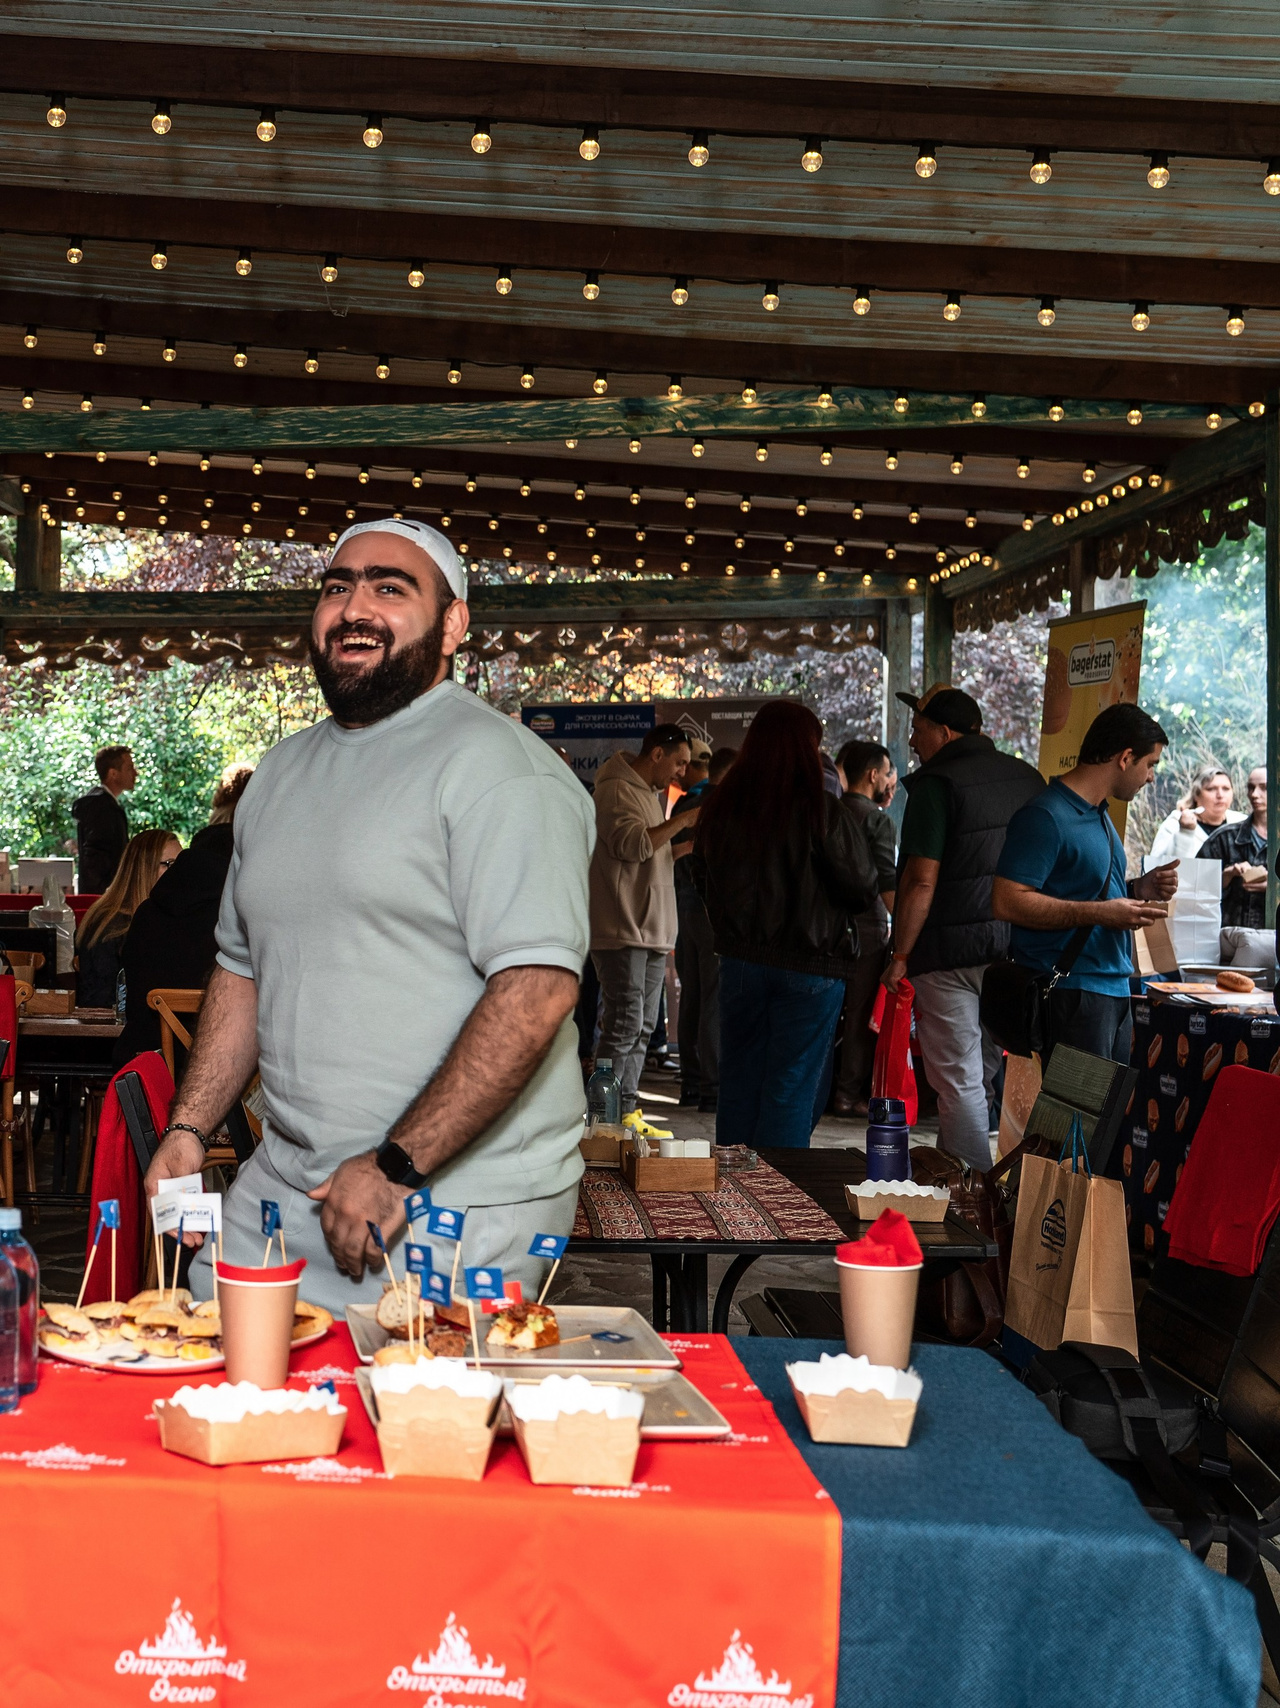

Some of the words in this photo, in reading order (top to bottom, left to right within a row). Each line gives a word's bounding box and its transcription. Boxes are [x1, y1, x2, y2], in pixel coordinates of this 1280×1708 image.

[575, 713, 607, 722] ЭКСПЕРТ
[614, 713, 641, 721] СЫРАХ
[581, 721, 652, 731] ПРОФЕССИОНАЛОВ
[1058, 755, 1078, 768] НАСТ
[114, 1649, 248, 1682] Открытый
[149, 1677, 217, 1703] Огонь
[386, 1665, 528, 1701] Открытый
